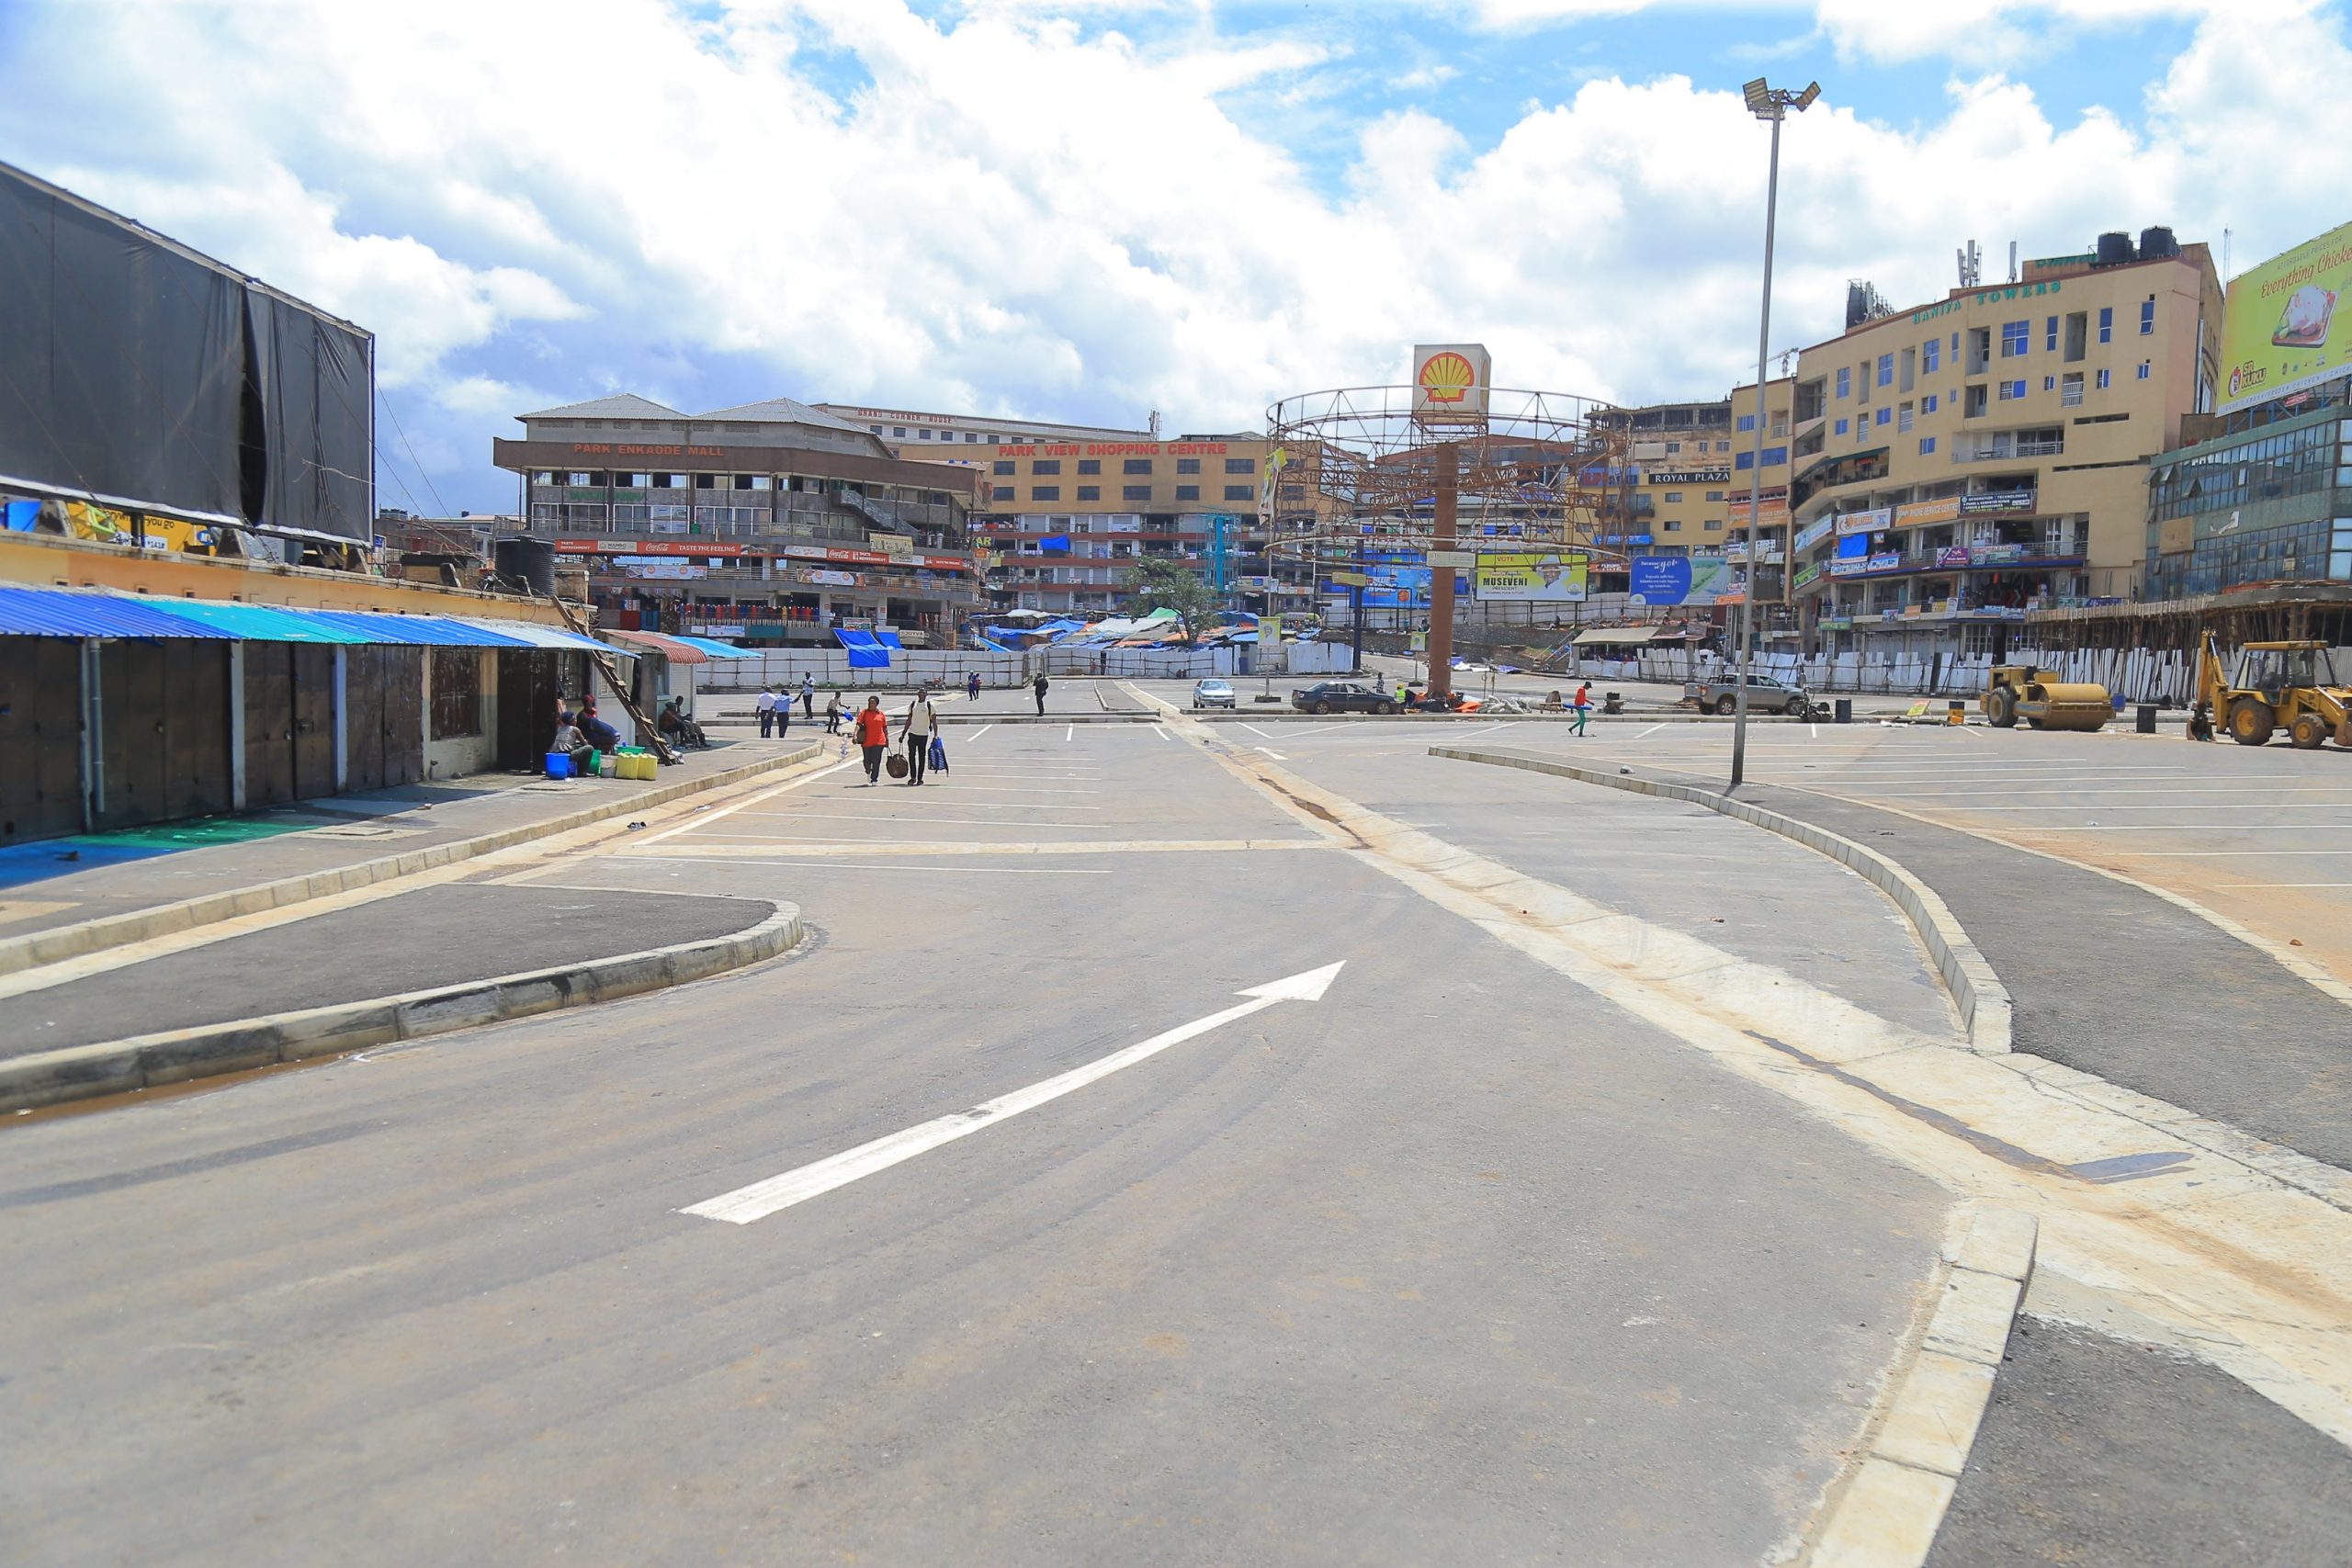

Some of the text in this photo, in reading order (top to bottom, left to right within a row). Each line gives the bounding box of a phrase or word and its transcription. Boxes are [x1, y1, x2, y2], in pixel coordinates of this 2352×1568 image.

[2261, 265, 2314, 299] Everything
[1912, 280, 2061, 325] HANIFA TOWERS
[2242, 367, 2267, 389] KUKU
[858, 409, 883, 418] GRAND
[929, 415, 953, 424] HOUSE
[573, 444, 611, 454] PARK
[688, 446, 726, 457] MALL
[999, 443, 1227, 457] PARK VIEW SHOPPING CENTRE
[1655, 472, 1729, 483] ROYAL PLAZA
[146, 517, 175, 530] you go
[1483, 578, 1528, 586] MUSEVENI
